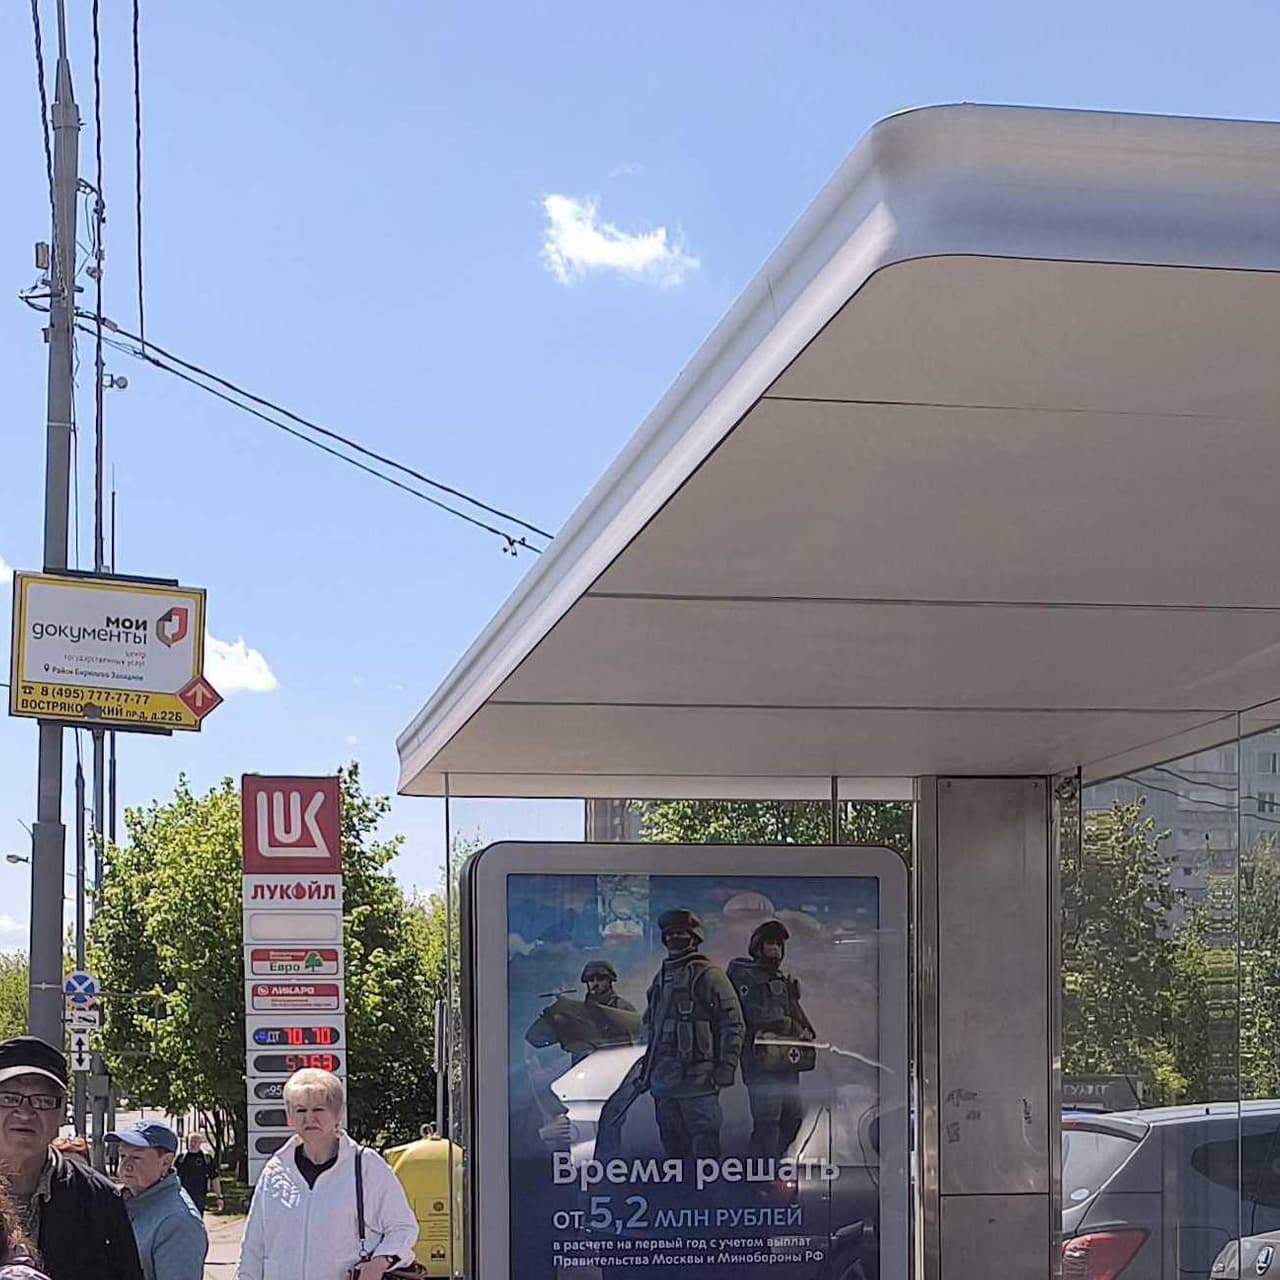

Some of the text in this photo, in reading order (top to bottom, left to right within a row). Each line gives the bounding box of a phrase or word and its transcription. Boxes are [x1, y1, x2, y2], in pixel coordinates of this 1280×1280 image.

[32, 621, 148, 645] документы
[105, 615, 148, 632] мои
[40, 686, 150, 705] 8 (495) 777-77-77
[21, 699, 123, 717] ВОСТРЯКОКИЙ
[251, 880, 336, 900] ЛУКОЙЛ
[269, 962, 301, 974] Евро
[552, 1151, 841, 1192] Время решать
[590, 1195, 649, 1235] 5,2
[716, 1204, 802, 1226] РУБЛЕЙ
[553, 1237, 812, 1253] в расчете на первый год с учетом выплат
[553, 1250, 825, 1269] Правительства Москвы и Минобороны РФ
